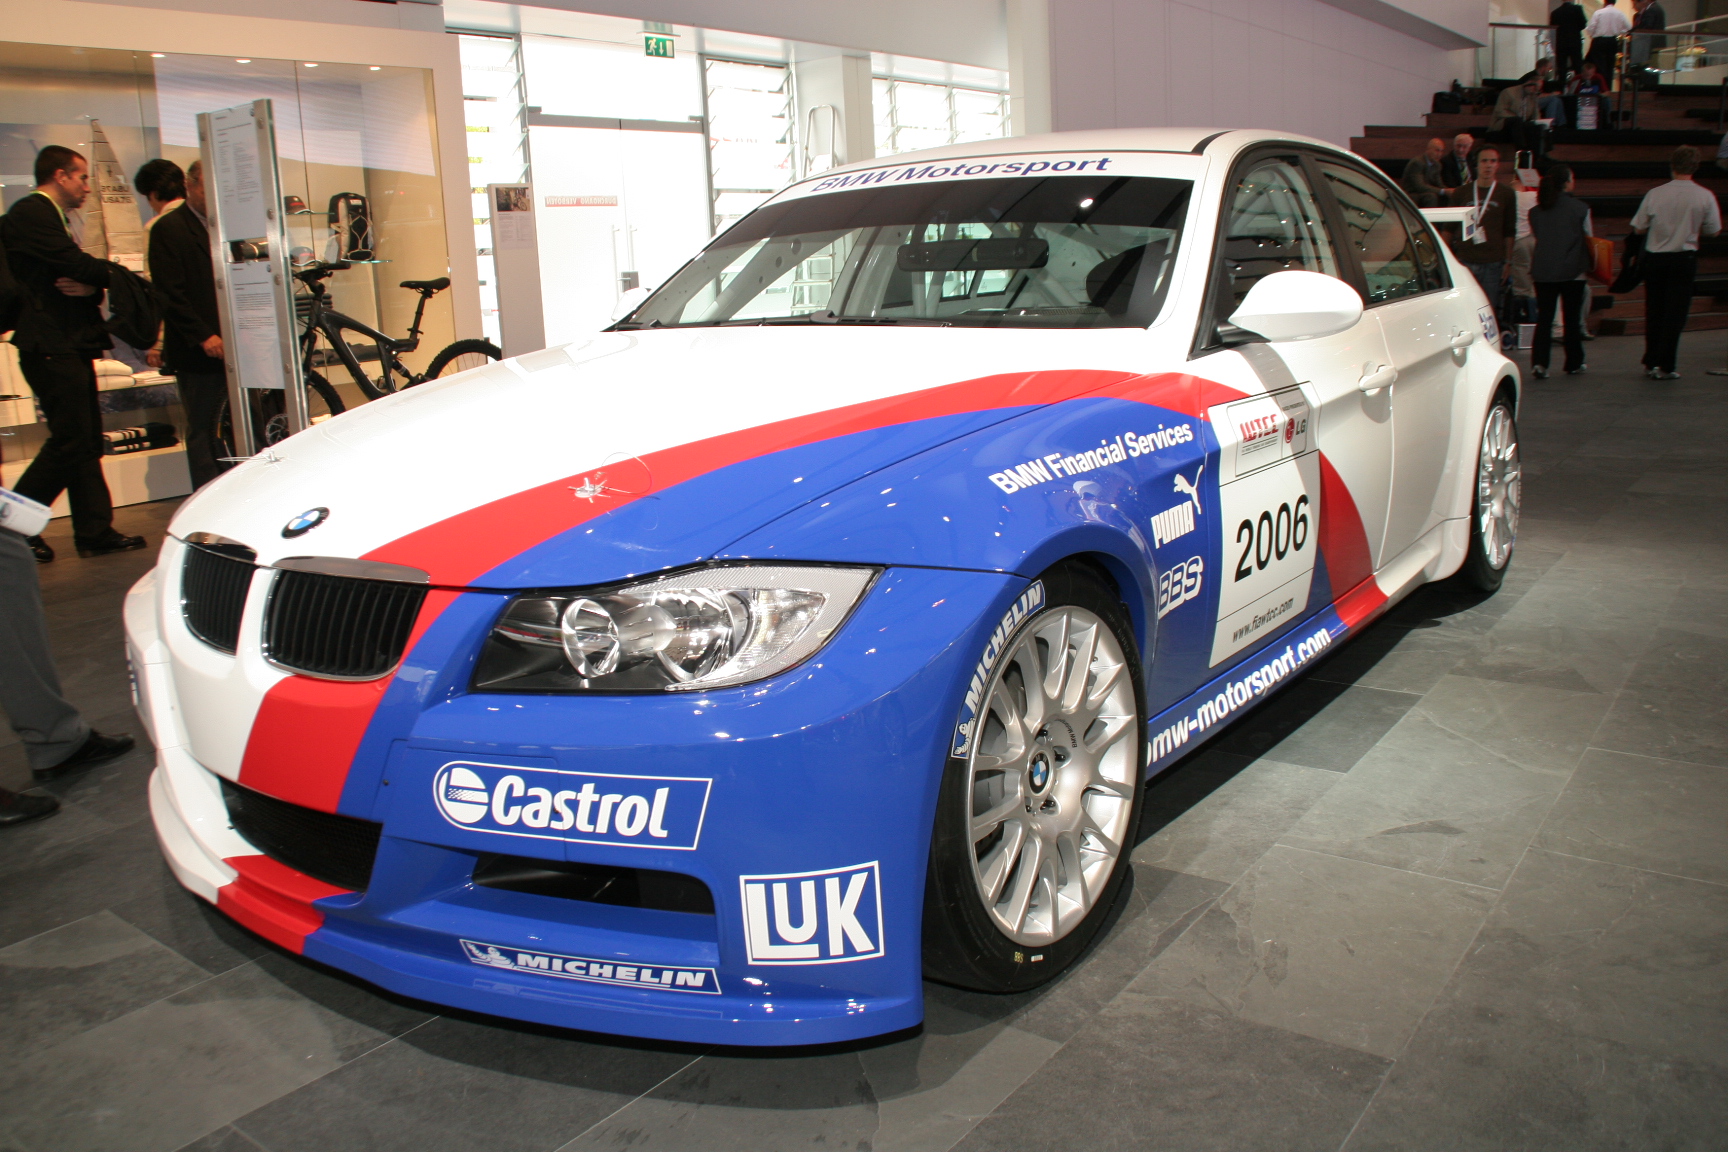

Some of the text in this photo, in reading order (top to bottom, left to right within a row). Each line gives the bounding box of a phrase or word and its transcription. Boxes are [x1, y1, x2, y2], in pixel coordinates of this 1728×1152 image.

[810, 157, 1113, 192] BMW Motorsport
[1296, 419, 1306, 435] LG
[988, 423, 1194, 494] BMW Financial Services
[1151, 500, 1194, 549] PUMA
[1234, 494, 1309, 583] 2006
[1158, 556, 1203, 619] BBS
[1232, 597, 1294, 643] www.fiawtcc.com
[965, 584, 1041, 715] MICHELIN
[491, 775, 669, 838] Castrol
[517, 952, 706, 987] MICHELIN
